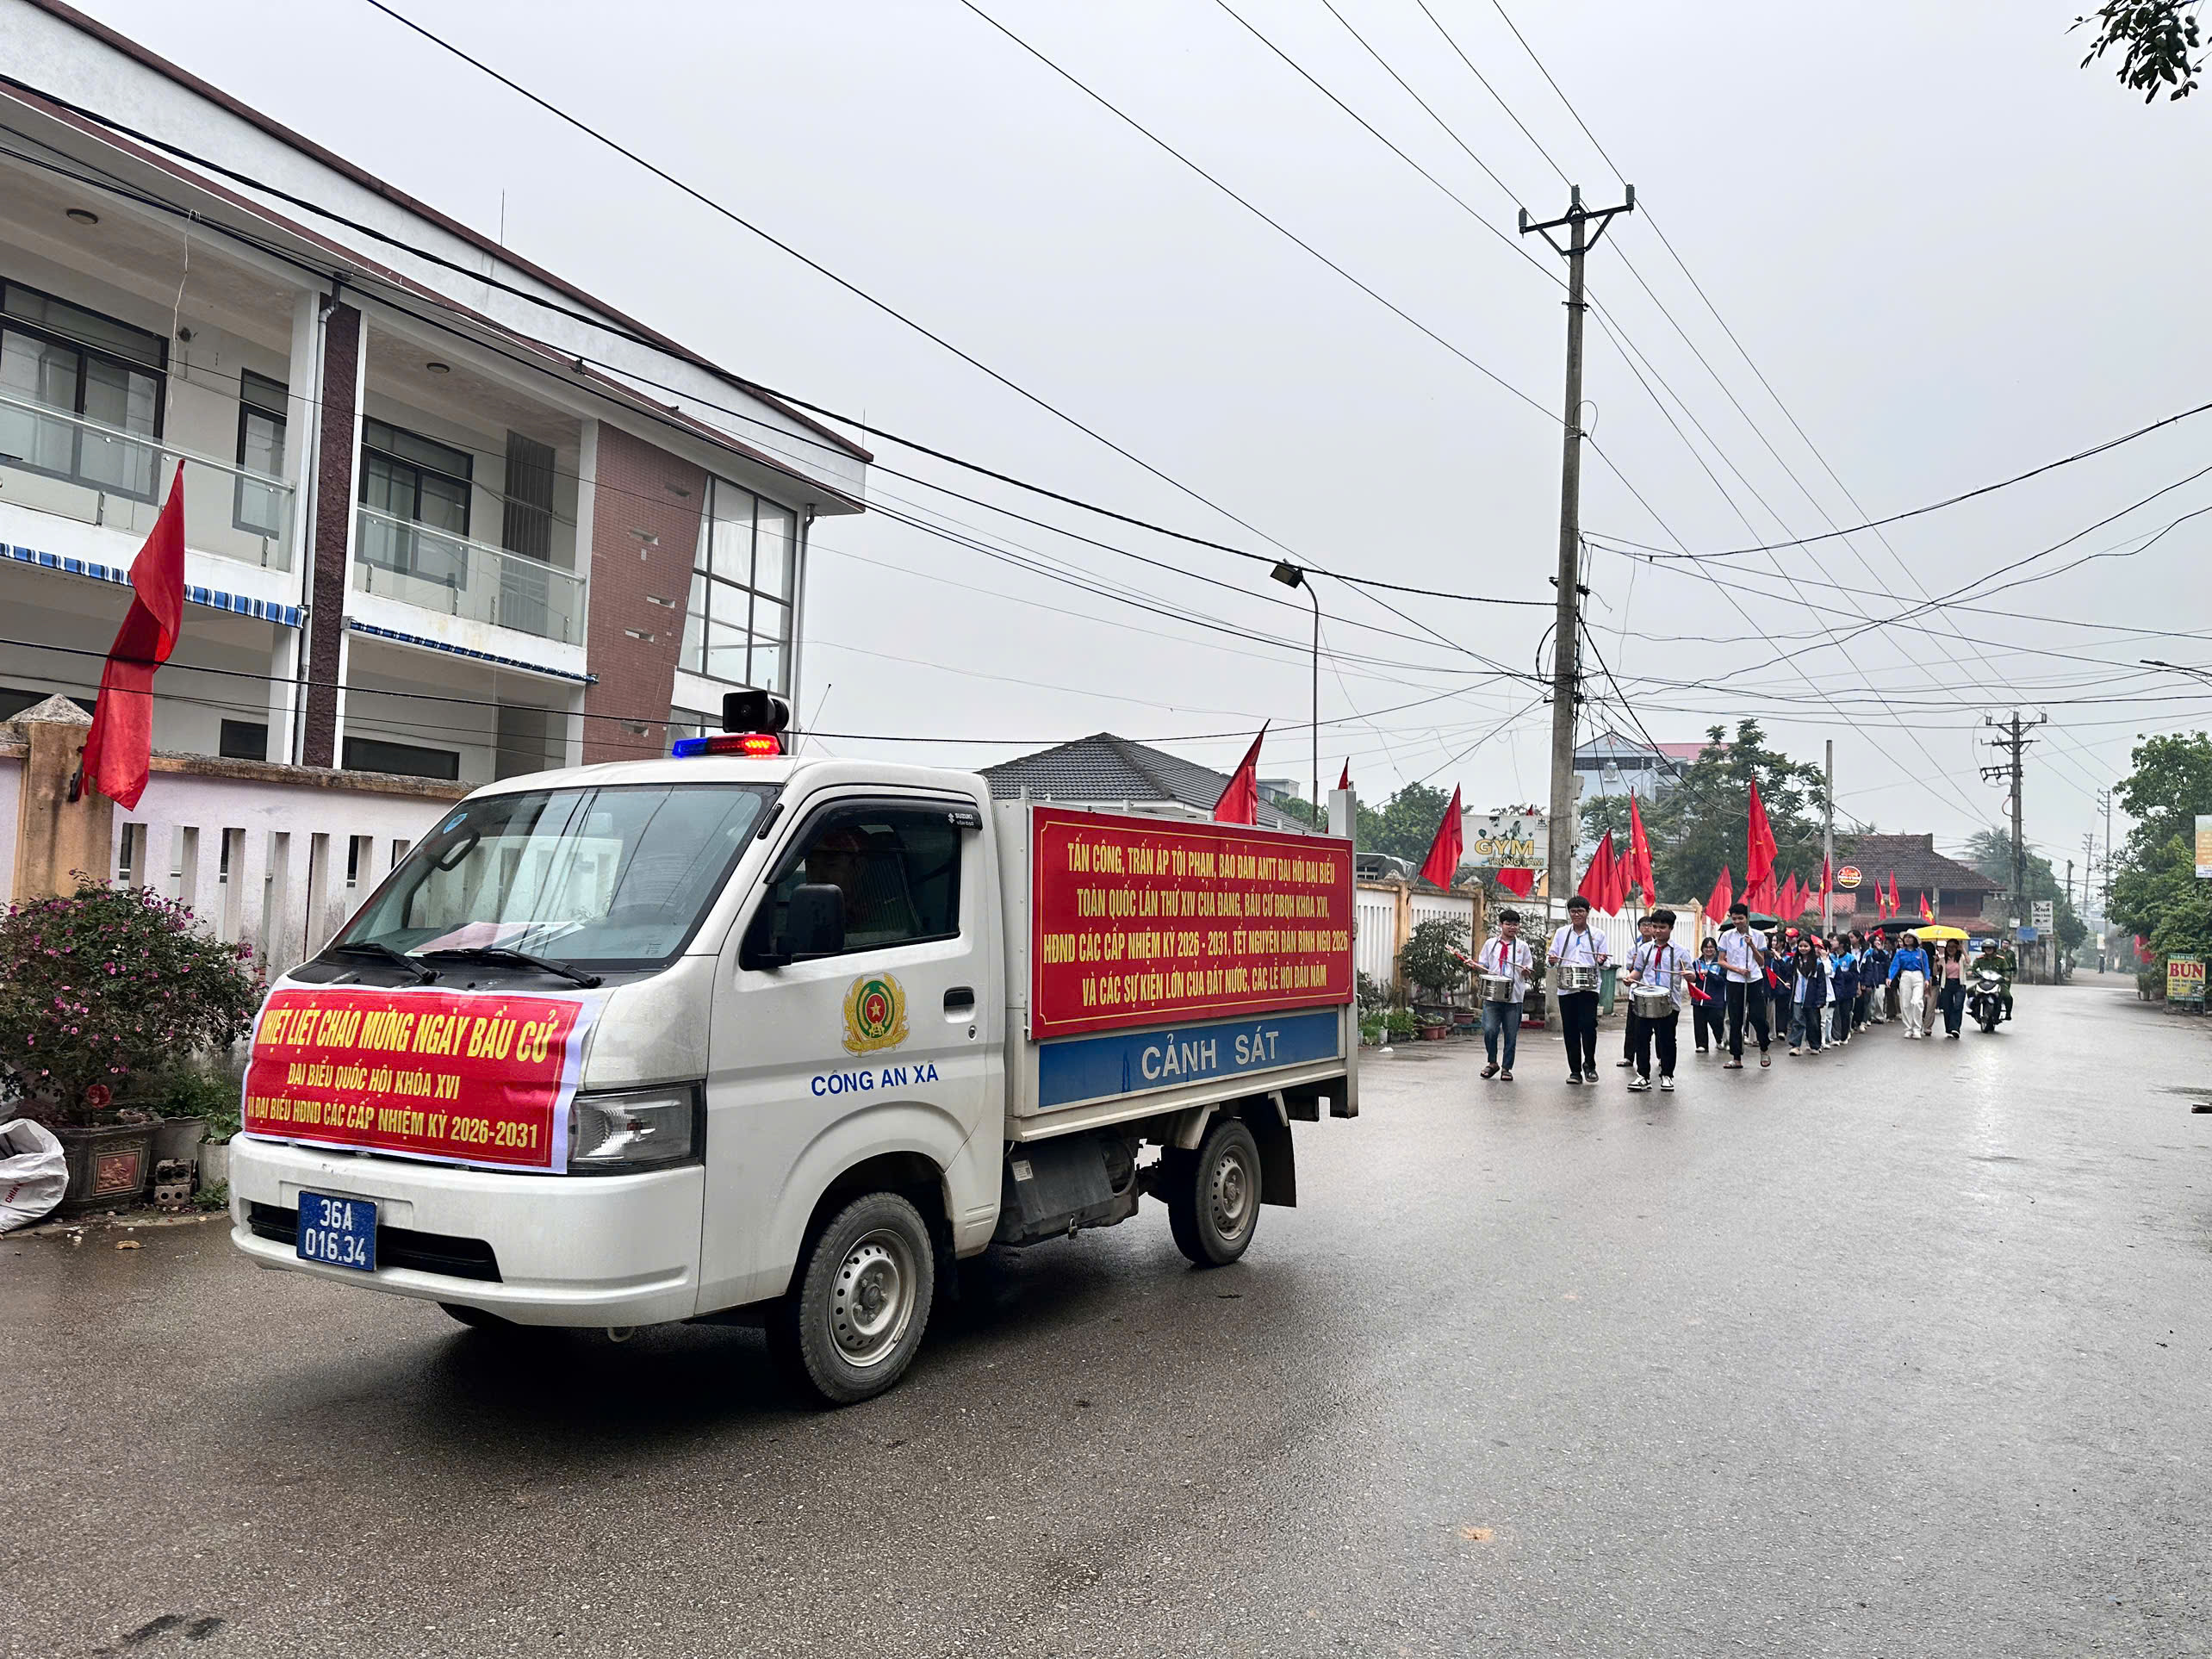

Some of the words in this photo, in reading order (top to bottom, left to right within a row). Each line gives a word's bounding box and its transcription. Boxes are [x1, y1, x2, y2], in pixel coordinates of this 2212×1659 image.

[1067, 833, 1090, 872] TẤN
[1092, 839, 1125, 877] CÔNG,
[1128, 838, 1153, 875] TRẤN
[1156, 843, 1169, 875] ÁP
[1171, 845, 1186, 882] TỘI
[1188, 852, 1216, 882] PHẠM,
[1219, 843, 1235, 879] BẢO
[1237, 845, 1256, 879] ĐẢM
[1258, 856, 1277, 880] ANTT
[1278, 858, 1290, 887] ĐẠI
[1292, 855, 1304, 888] HỘI
[1306, 861, 1318, 888] ĐẠI
[1320, 854, 1335, 884] BIỂU
[1475, 838, 1534, 855] GYM
[1488, 857, 1520, 866] TRUNG
[1077, 883, 1105, 917] TOÀN
[1109, 880, 1136, 920] QUỐC
[1139, 880, 1159, 916] LẦN
[1160, 883, 1180, 916] THỨ
[1180, 891, 1196, 916] XIV
[1198, 881, 1215, 916] CỦA
[1217, 881, 1243, 920] ĐẢNG,
[1245, 885, 1260, 917] BẦU
[1262, 884, 1274, 917] CỬ
[1274, 894, 1295, 920] ĐBQH
[1296, 891, 1315, 917] KHÓA
[1316, 896, 1330, 920] XVI,
[1043, 934, 1075, 964] HĐND
[1078, 927, 1101, 962] CÁC
[1103, 923, 1125, 960] CẤP
[1128, 926, 1160, 965] NHIỆM
[1163, 926, 1175, 958] KỲ
[1177, 931, 1200, 957] 2026
[1208, 930, 1231, 958] 2031,
[1233, 922, 1247, 954] TẾT
[1248, 924, 1279, 954] NGUYÊN
[1298, 925, 1315, 953] BÍNH
[1316, 930, 1331, 957] NGỌ
[1332, 930, 1348, 952] 2026
[1082, 972, 1097, 1007] VÀ
[1099, 970, 1121, 1005] CÁC
[1123, 972, 1140, 1009] SỰ
[1140, 967, 1163, 1007] KIỆN
[1165, 964, 1184, 999] LỚN
[1186, 960, 1205, 997] CỦA
[1207, 960, 1222, 996] ĐẤT
[1225, 960, 1250, 995] NƯỚC,
[1252, 962, 1268, 991] CÁC
[1270, 957, 1278, 990] LỄ
[1280, 961, 1292, 994] HỘI
[1310, 960, 1327, 987] NĂM
[2169, 961, 2203, 979] BÚN
[287, 1002, 321, 1054] LIỆT
[316, 1003, 362, 1048] CHÀO
[358, 1003, 414, 1052] MỪNG
[412, 1007, 470, 1056] NGÀY
[466, 1005, 517, 1060] BẦU
[516, 1009, 559, 1063] CỬ
[1141, 1034, 1216, 1080] CẢNH
[1235, 1025, 1279, 1066] SÁT
[287, 1062, 307, 1090] ĐẠI
[307, 1055, 333, 1088] BIỂU
[334, 1059, 368, 1090] QUỐC
[368, 1064, 393, 1098] HỘI
[394, 1067, 431, 1097] KHÓA
[434, 1073, 461, 1100] XVI
[811, 1070, 874, 1097] CÔNG
[881, 1066, 908, 1088] AN
[255, 1097, 269, 1123] ĐẠI
[270, 1090, 291, 1121] BIỂU
[292, 1099, 321, 1124] HĐND
[323, 1097, 345, 1127] CÁC
[346, 1097, 375, 1129] CẤP
[378, 1105, 425, 1140] NHIỆM
[427, 1109, 448, 1139] KỲ
[450, 1115, 537, 1148] 2026-2031
[320, 1199, 352, 1231] 36A
[305, 1227, 365, 1265] 016.34
